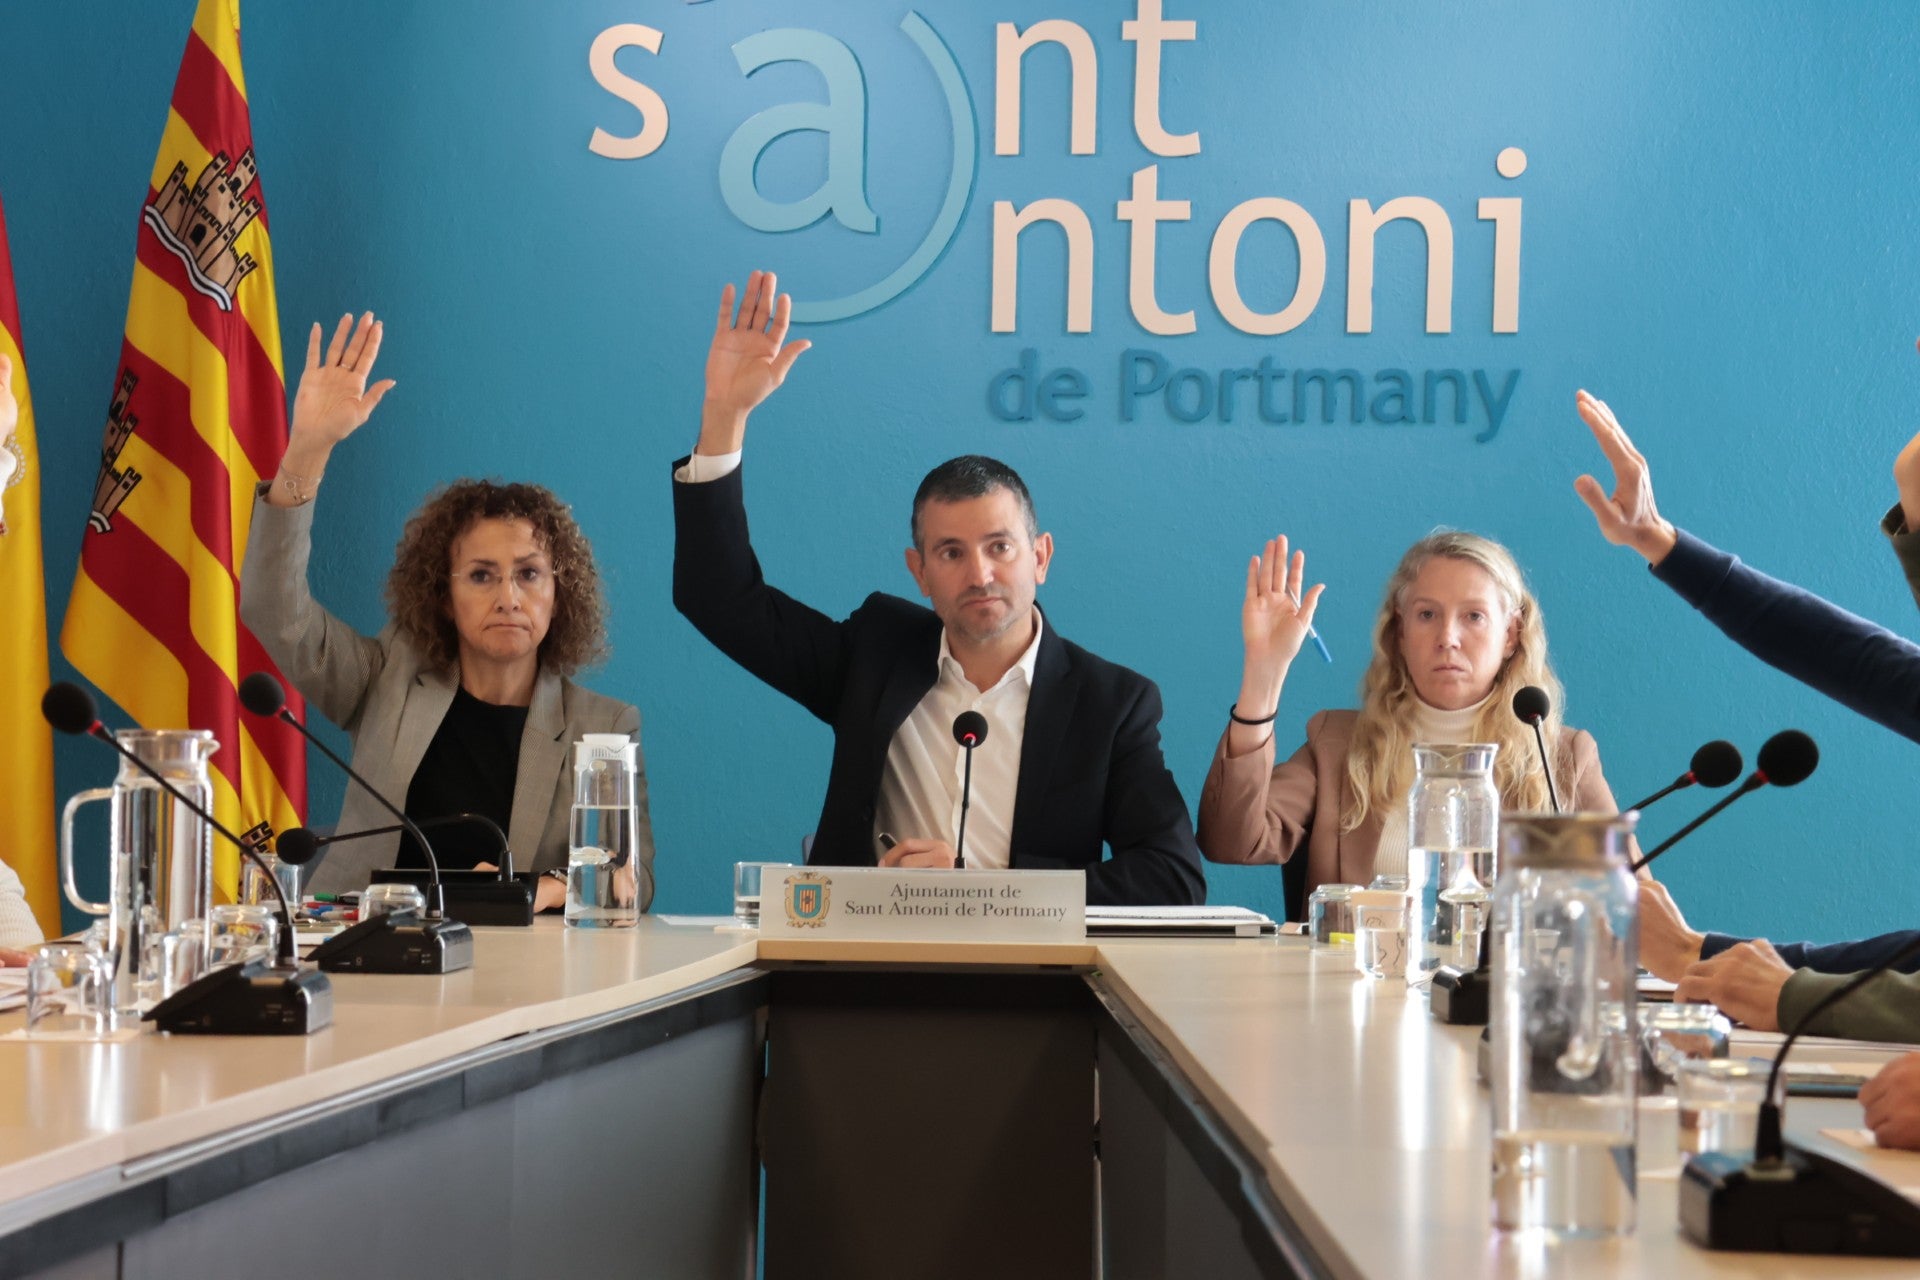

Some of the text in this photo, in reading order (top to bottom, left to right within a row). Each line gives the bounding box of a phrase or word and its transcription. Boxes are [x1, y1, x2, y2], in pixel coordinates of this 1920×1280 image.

[990, 347, 1520, 443] de Portmany
[890, 882, 1022, 901] Ajuntament de
[844, 900, 1067, 921] Sant Antoni de Portmany
